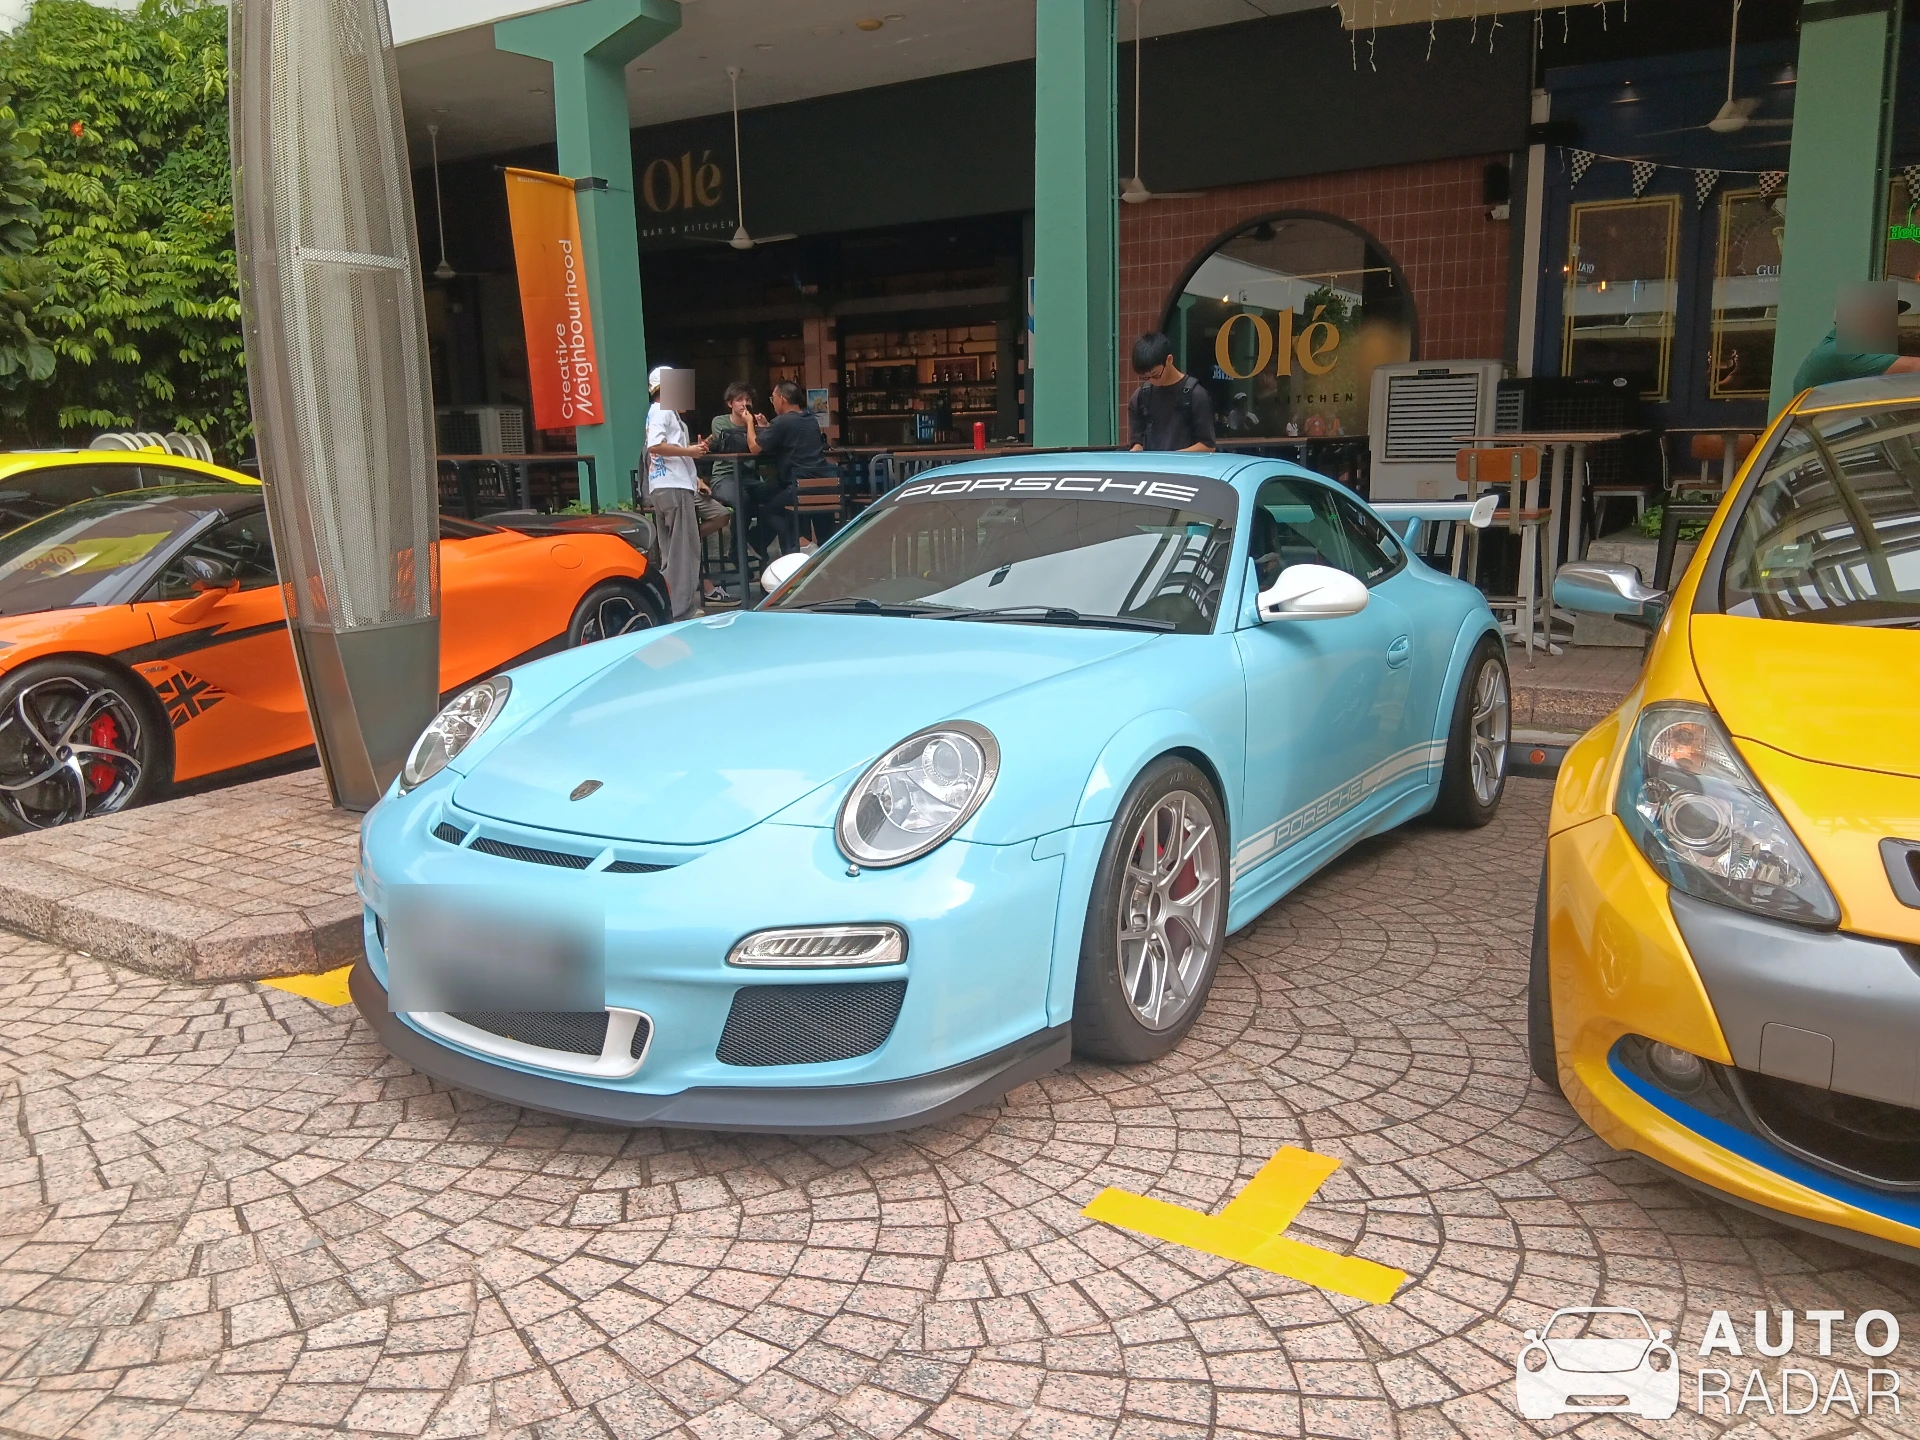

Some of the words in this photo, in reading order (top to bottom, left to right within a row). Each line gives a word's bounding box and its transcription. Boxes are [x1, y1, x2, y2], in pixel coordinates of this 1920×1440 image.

[643, 149, 723, 213] Olé
[642, 227, 664, 237] BAR
[684, 220, 735, 233] KITCHEN
[1756, 264, 1781, 277] GUI
[558, 239, 595, 417] Neighbourhood
[1214, 304, 1340, 380] Olé
[556, 322, 574, 420] Creative
[1274, 392, 1353, 405] KITCHEN
[894, 477, 1199, 502] PORSCHE
[1275, 780, 1362, 846] PORSCHE
